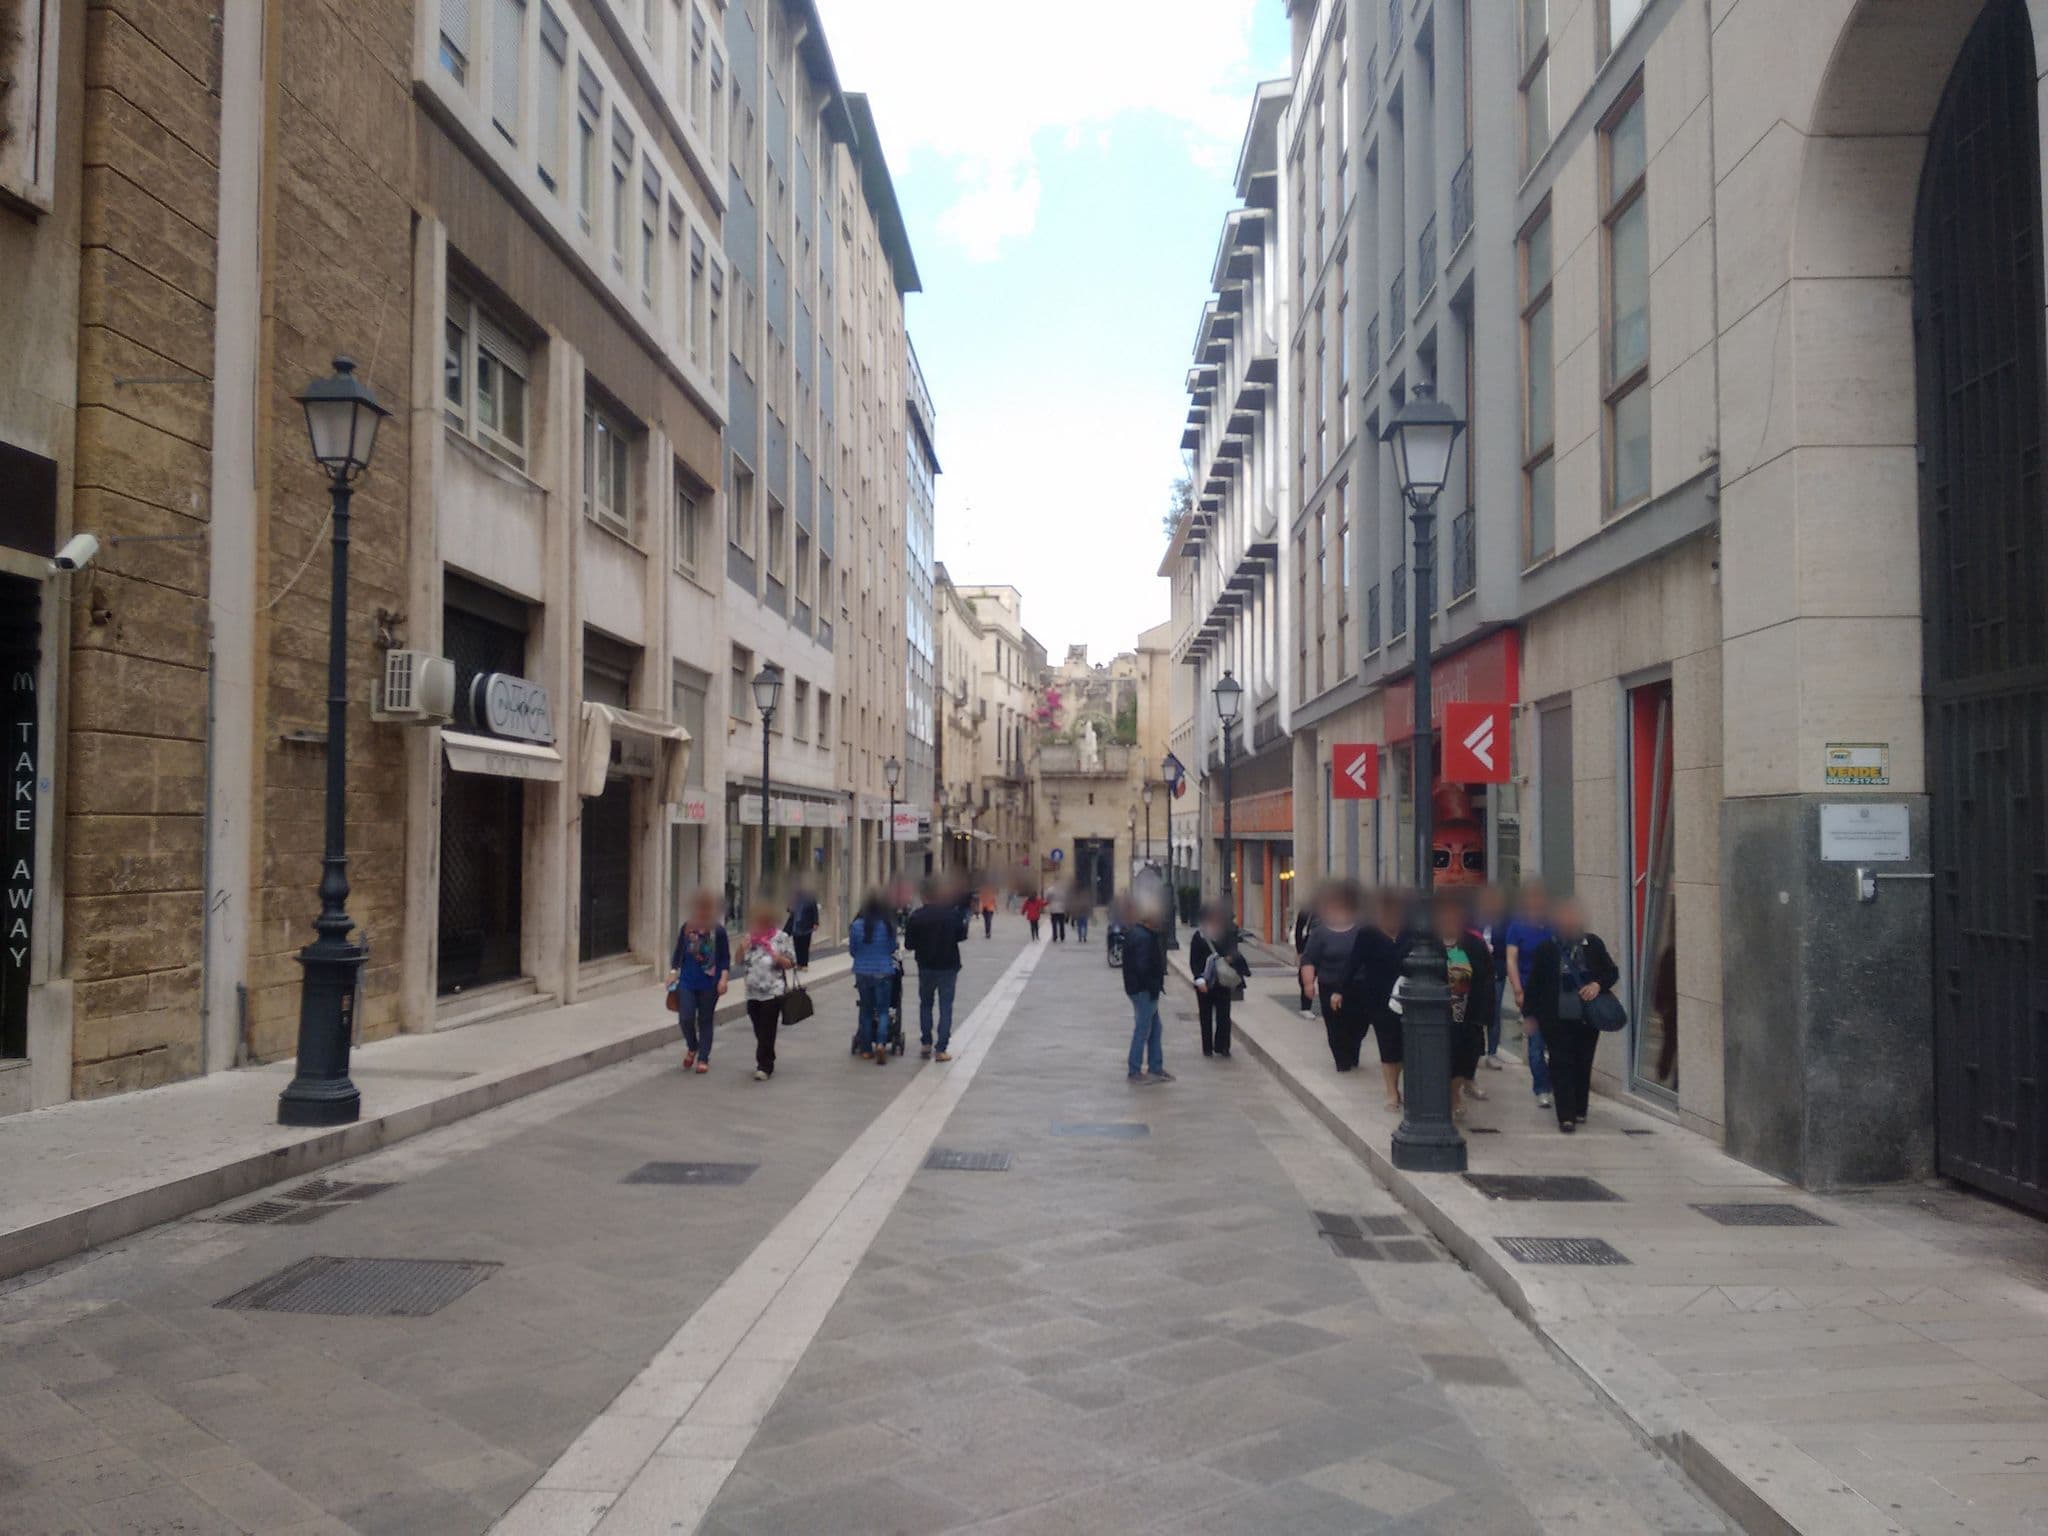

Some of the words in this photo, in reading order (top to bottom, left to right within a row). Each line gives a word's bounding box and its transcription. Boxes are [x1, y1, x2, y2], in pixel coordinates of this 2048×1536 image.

[15, 722, 35, 832] TAKE
[1827, 767, 1881, 778] VENDE
[8, 858, 34, 968] AWAY
